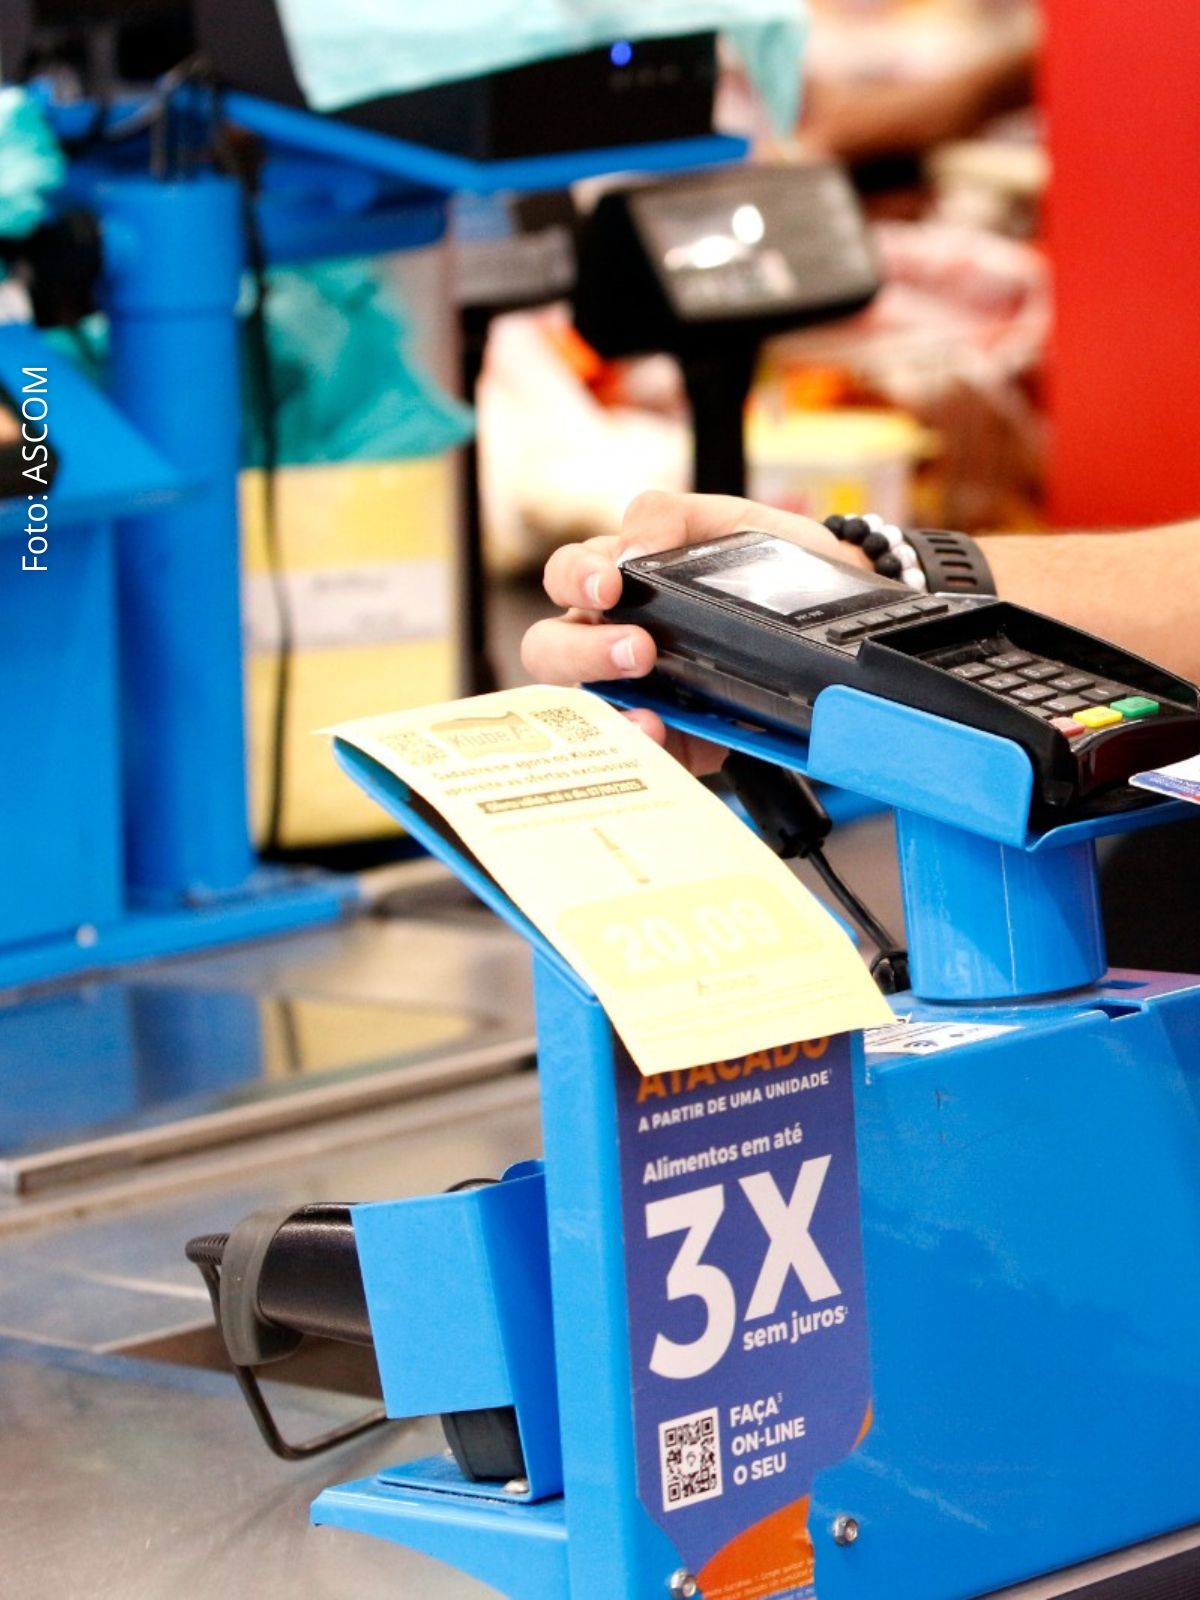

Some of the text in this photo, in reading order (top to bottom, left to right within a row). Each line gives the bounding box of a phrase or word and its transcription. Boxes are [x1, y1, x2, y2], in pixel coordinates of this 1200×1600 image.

[637, 1116, 650, 1133] A
[651, 1103, 705, 1129] PARTIR
[707, 1096, 728, 1115] DE
[729, 1088, 763, 1108] UMA
[642, 1122, 804, 1184] Alimentos em até
[645, 1154, 842, 1380] 3X
[743, 1321, 789, 1351] sem
[731, 1416, 806, 1457] ON-LINE
[733, 1451, 788, 1486] O SEU
